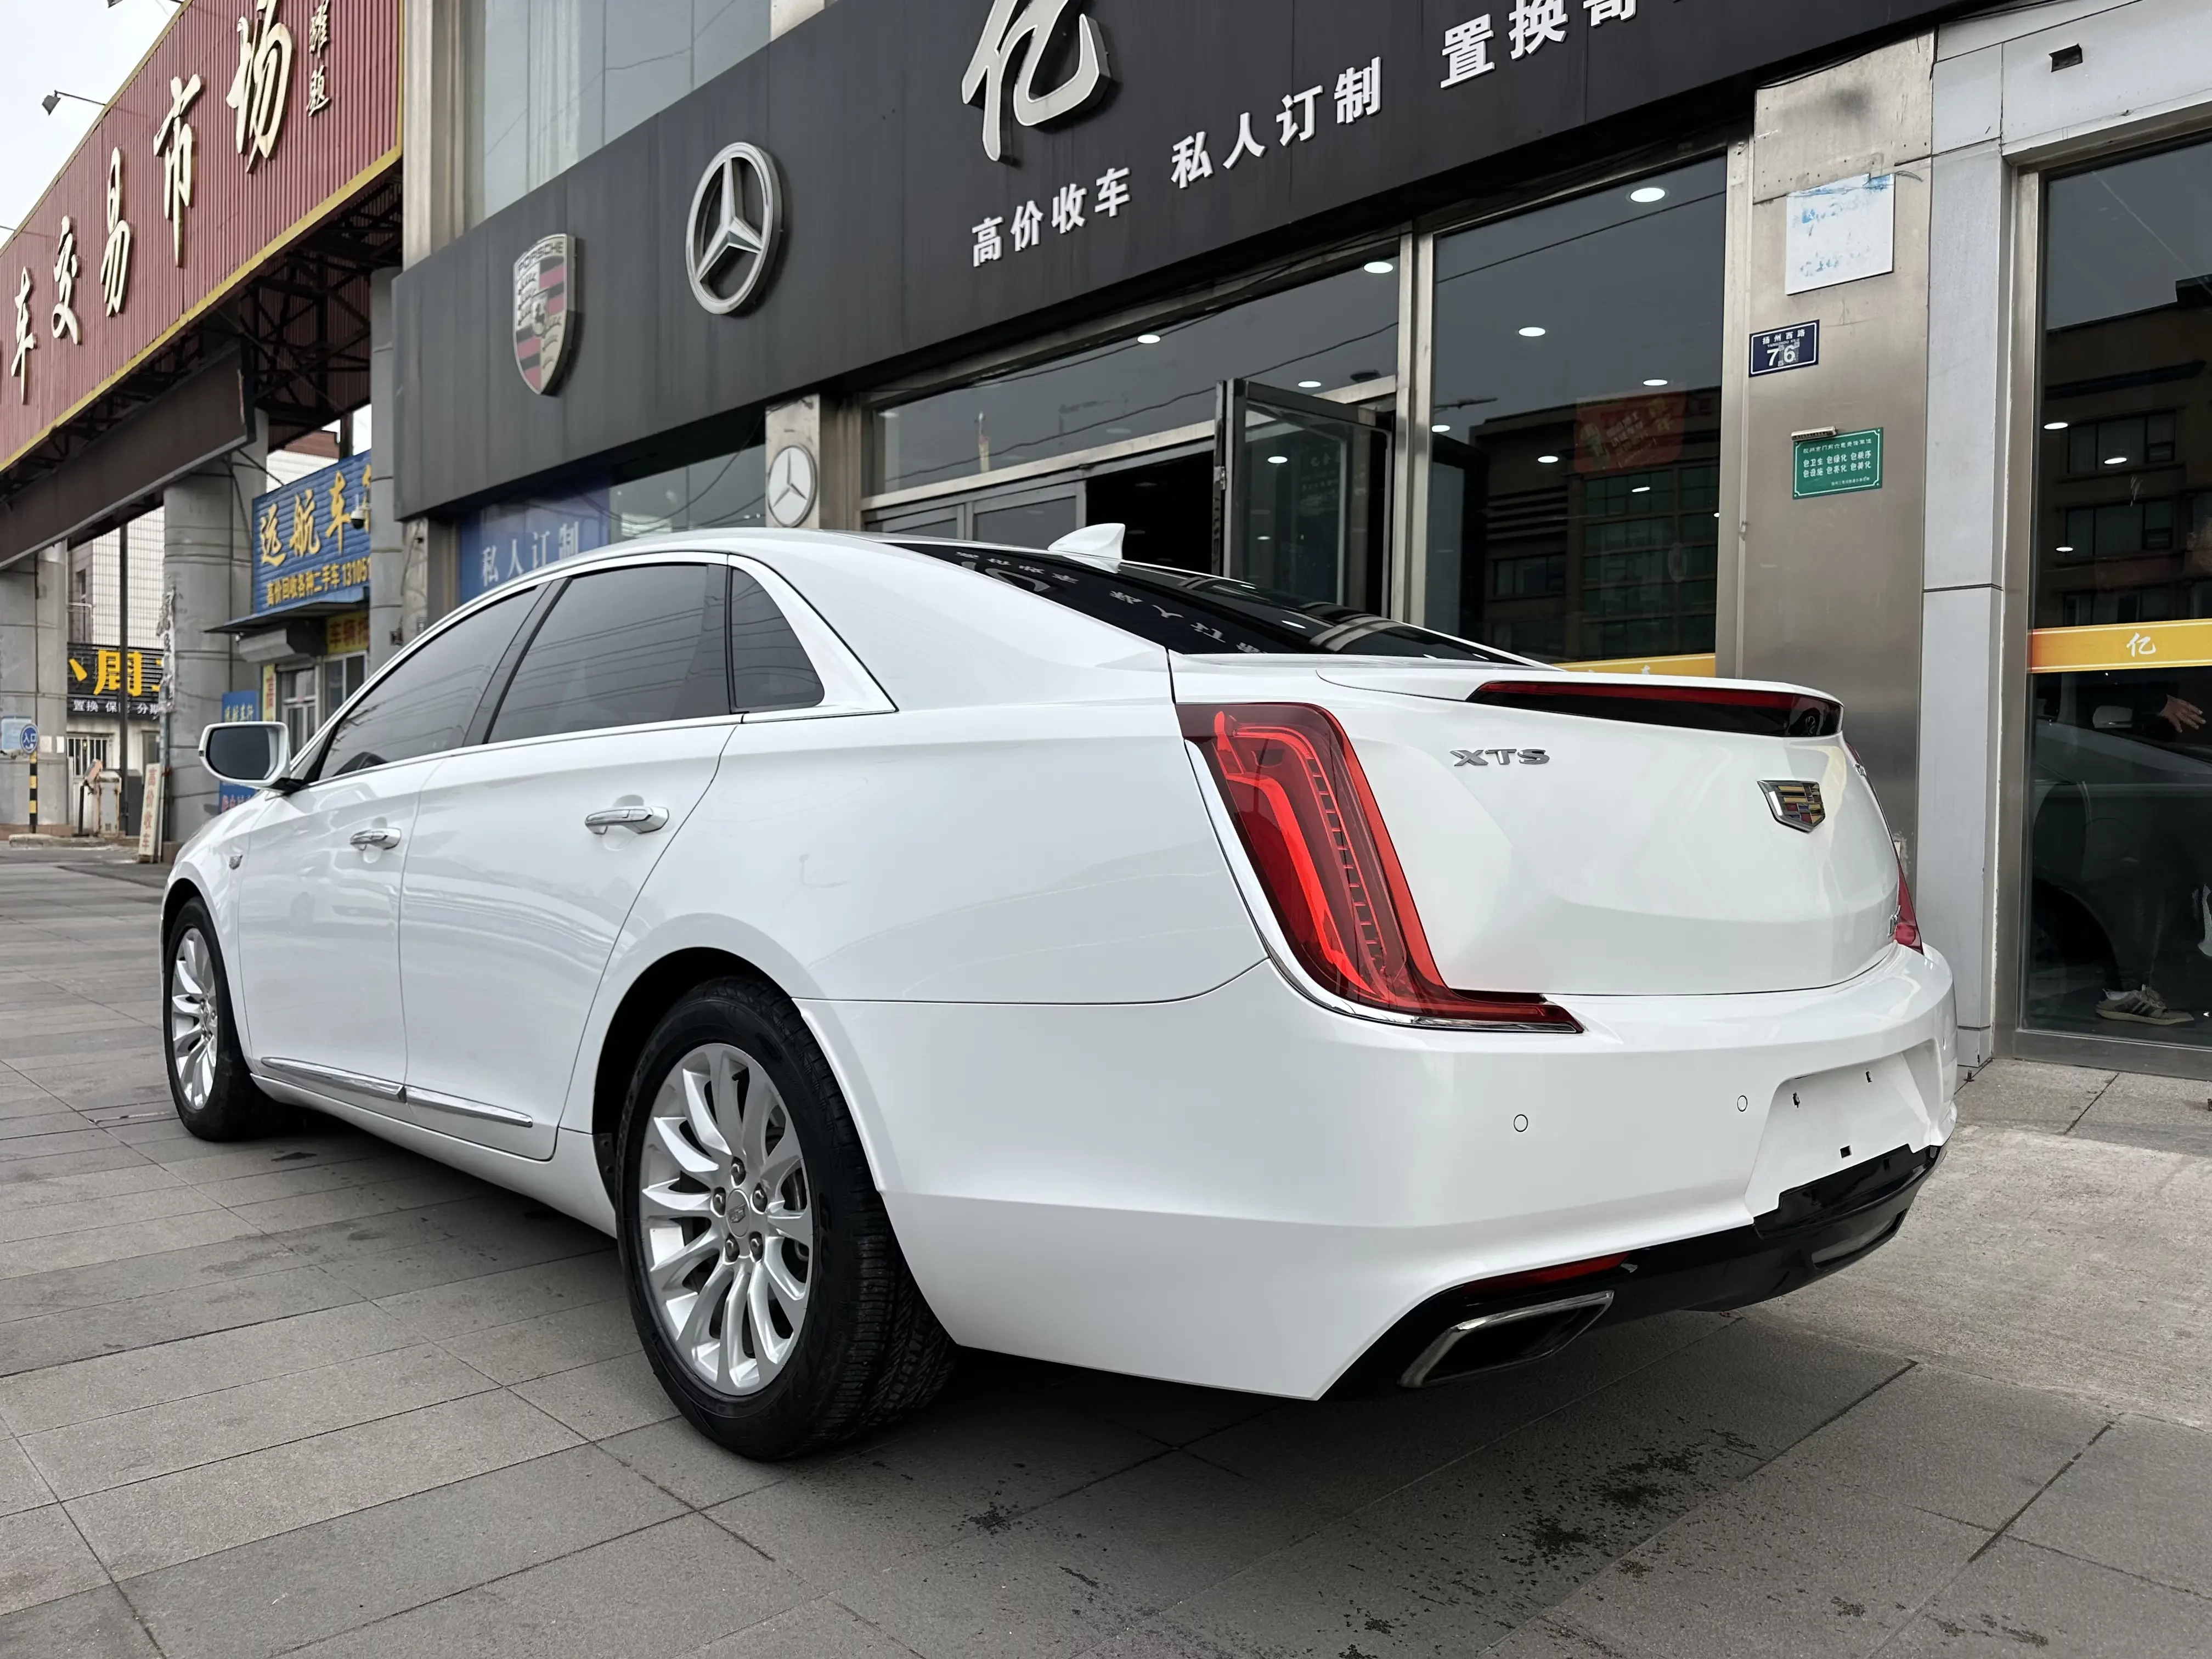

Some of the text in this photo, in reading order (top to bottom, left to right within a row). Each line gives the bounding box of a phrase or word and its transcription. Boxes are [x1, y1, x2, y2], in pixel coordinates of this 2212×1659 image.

[962, 0, 1100, 161] 亿
[972, 167, 1131, 267] 高价收车
[1170, 57, 1383, 189] 私人订制
[517, 240, 563, 272] PORSCHE
[1762, 329, 1805, 345] 扬州西路
[1767, 345, 1797, 366] 76
[1803, 457, 1824, 468] 包卫生
[1850, 450, 1872, 461] 包秩序
[482, 521, 579, 586] 私人订制
[266, 562, 340, 606] 高价回收各种二手车
[2126, 632, 2157, 657] 亿
[72, 699, 99, 713] 置换
[22, 732, 37, 743] 入口
[1449, 748, 1550, 768] XTS
[141, 766, 157, 852] 高价收车
